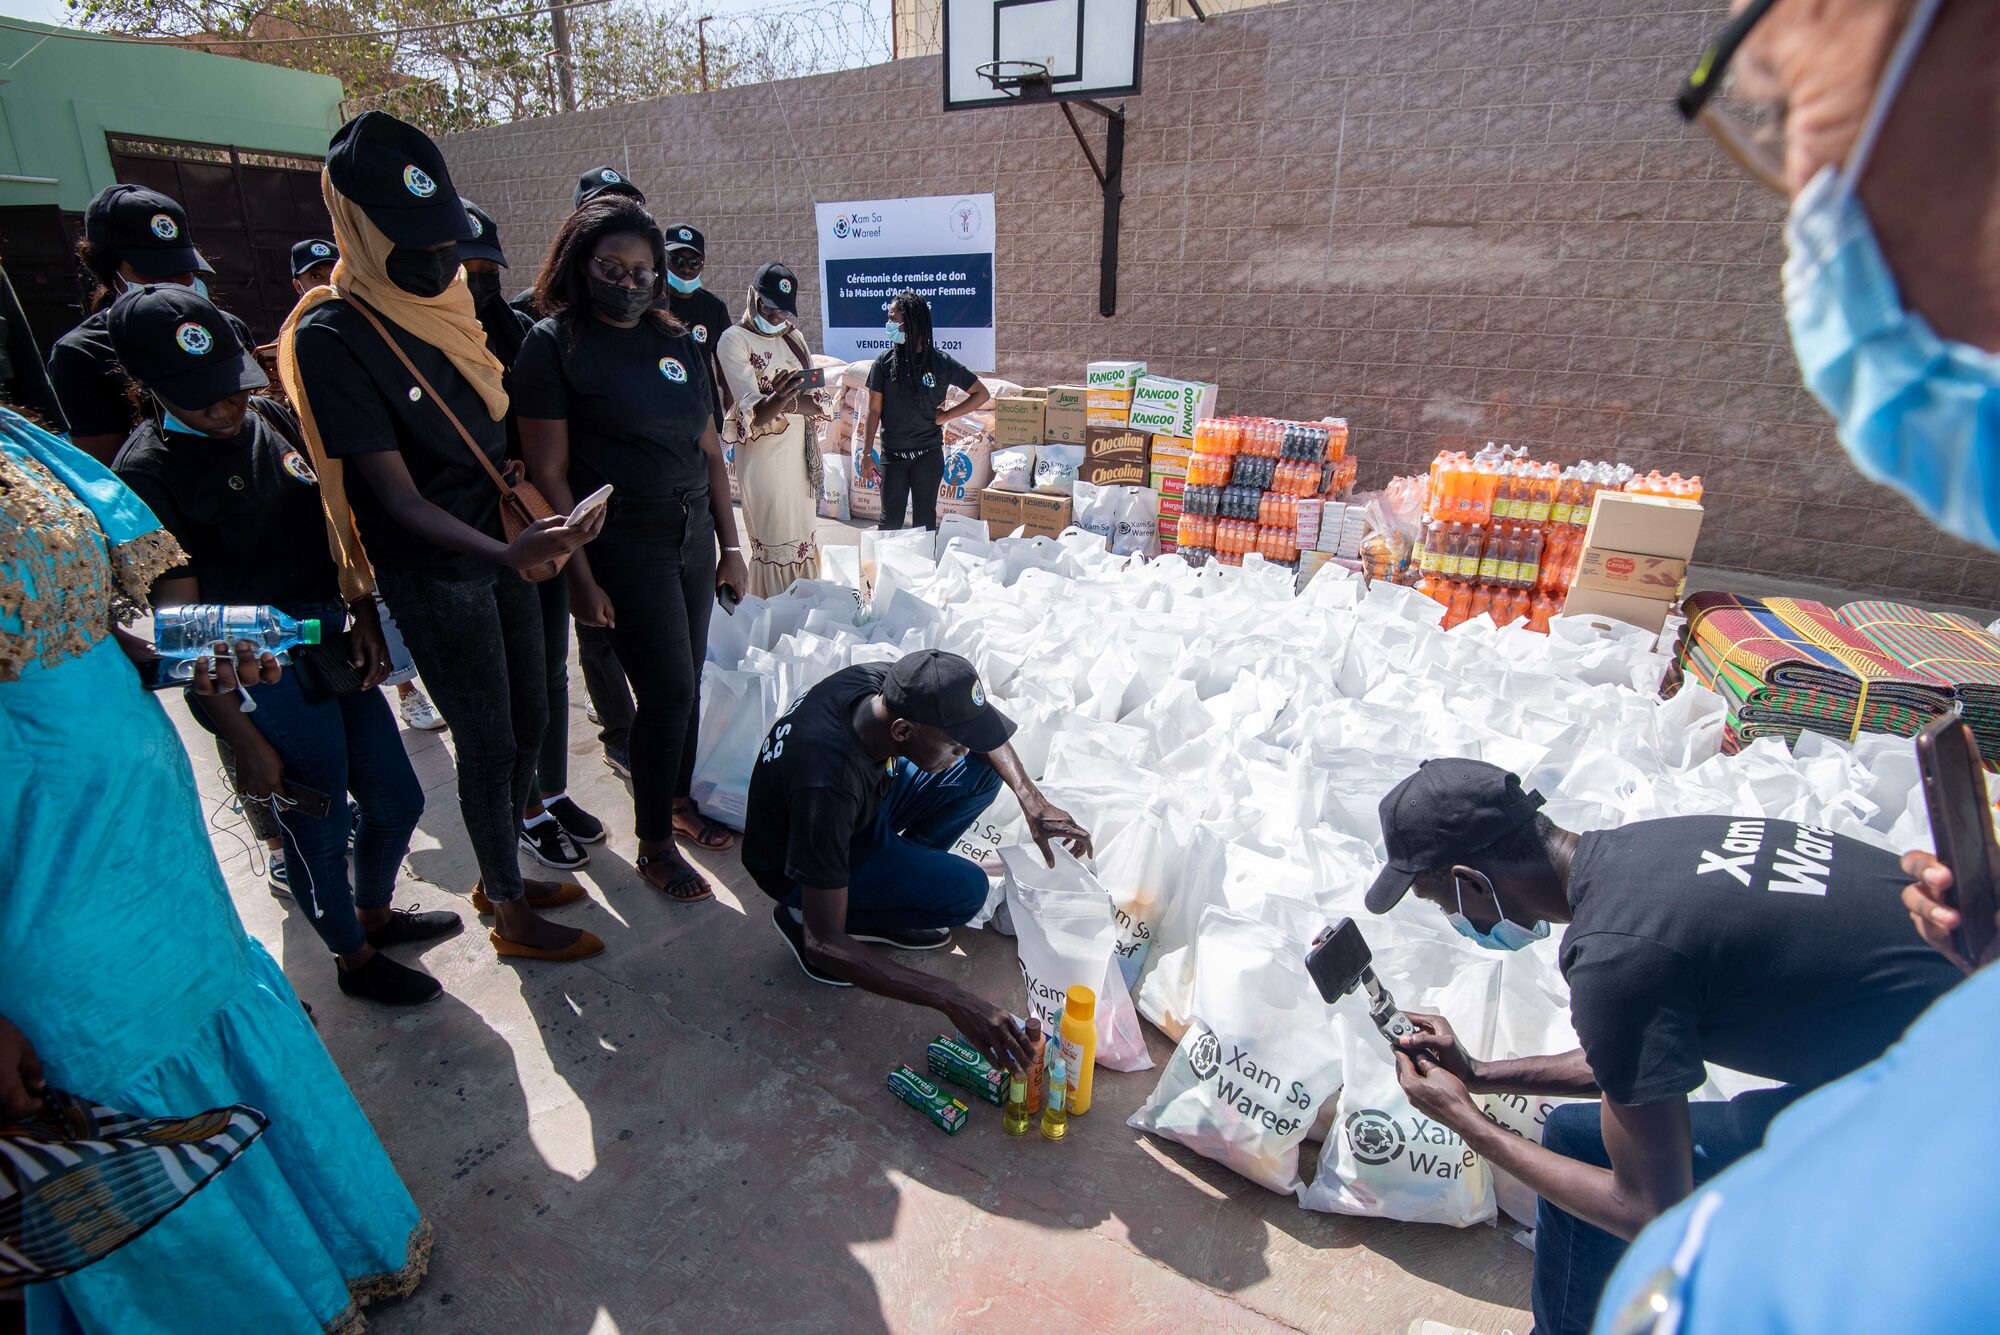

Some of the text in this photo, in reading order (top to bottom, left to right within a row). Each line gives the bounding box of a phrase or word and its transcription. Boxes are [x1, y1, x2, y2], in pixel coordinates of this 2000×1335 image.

[852, 212, 882, 224] Xam Sa
[852, 226, 881, 238] Wareef
[847, 271, 967, 284] Cérémonie de remise de don
[846, 288, 854, 298] la
[855, 287, 883, 298] Maison
[916, 288, 936, 296] pour
[938, 286, 976, 296] Femmes
[856, 340, 893, 349] VENDRE
[942, 341, 962, 350] 2021
[1089, 369, 1125, 384] KANGOO
[1136, 388, 1179, 400] KANGOO
[1131, 413, 1175, 425] KANGOO
[1182, 388, 1193, 436] KANGOO
[1092, 432, 1144, 455] Chocolion
[1092, 464, 1144, 484] Chocolion
[940, 485, 965, 500] GMD
[774, 723, 792, 759] Sa
[981, 825, 1002, 845] Sa
[955, 839, 992, 862] reef
[1696, 820, 1765, 887] Xam
[1768, 823, 1834, 896] Ware
[1132, 922, 1150, 939] Sa
[1029, 978, 1065, 1003] Xam
[940, 1038, 974, 1060] DENTYGEL
[901, 1068, 934, 1093] DENTYGEL
[1225, 1045, 1311, 1110] Xam Sa
[1217, 1075, 1301, 1136] Wareef
